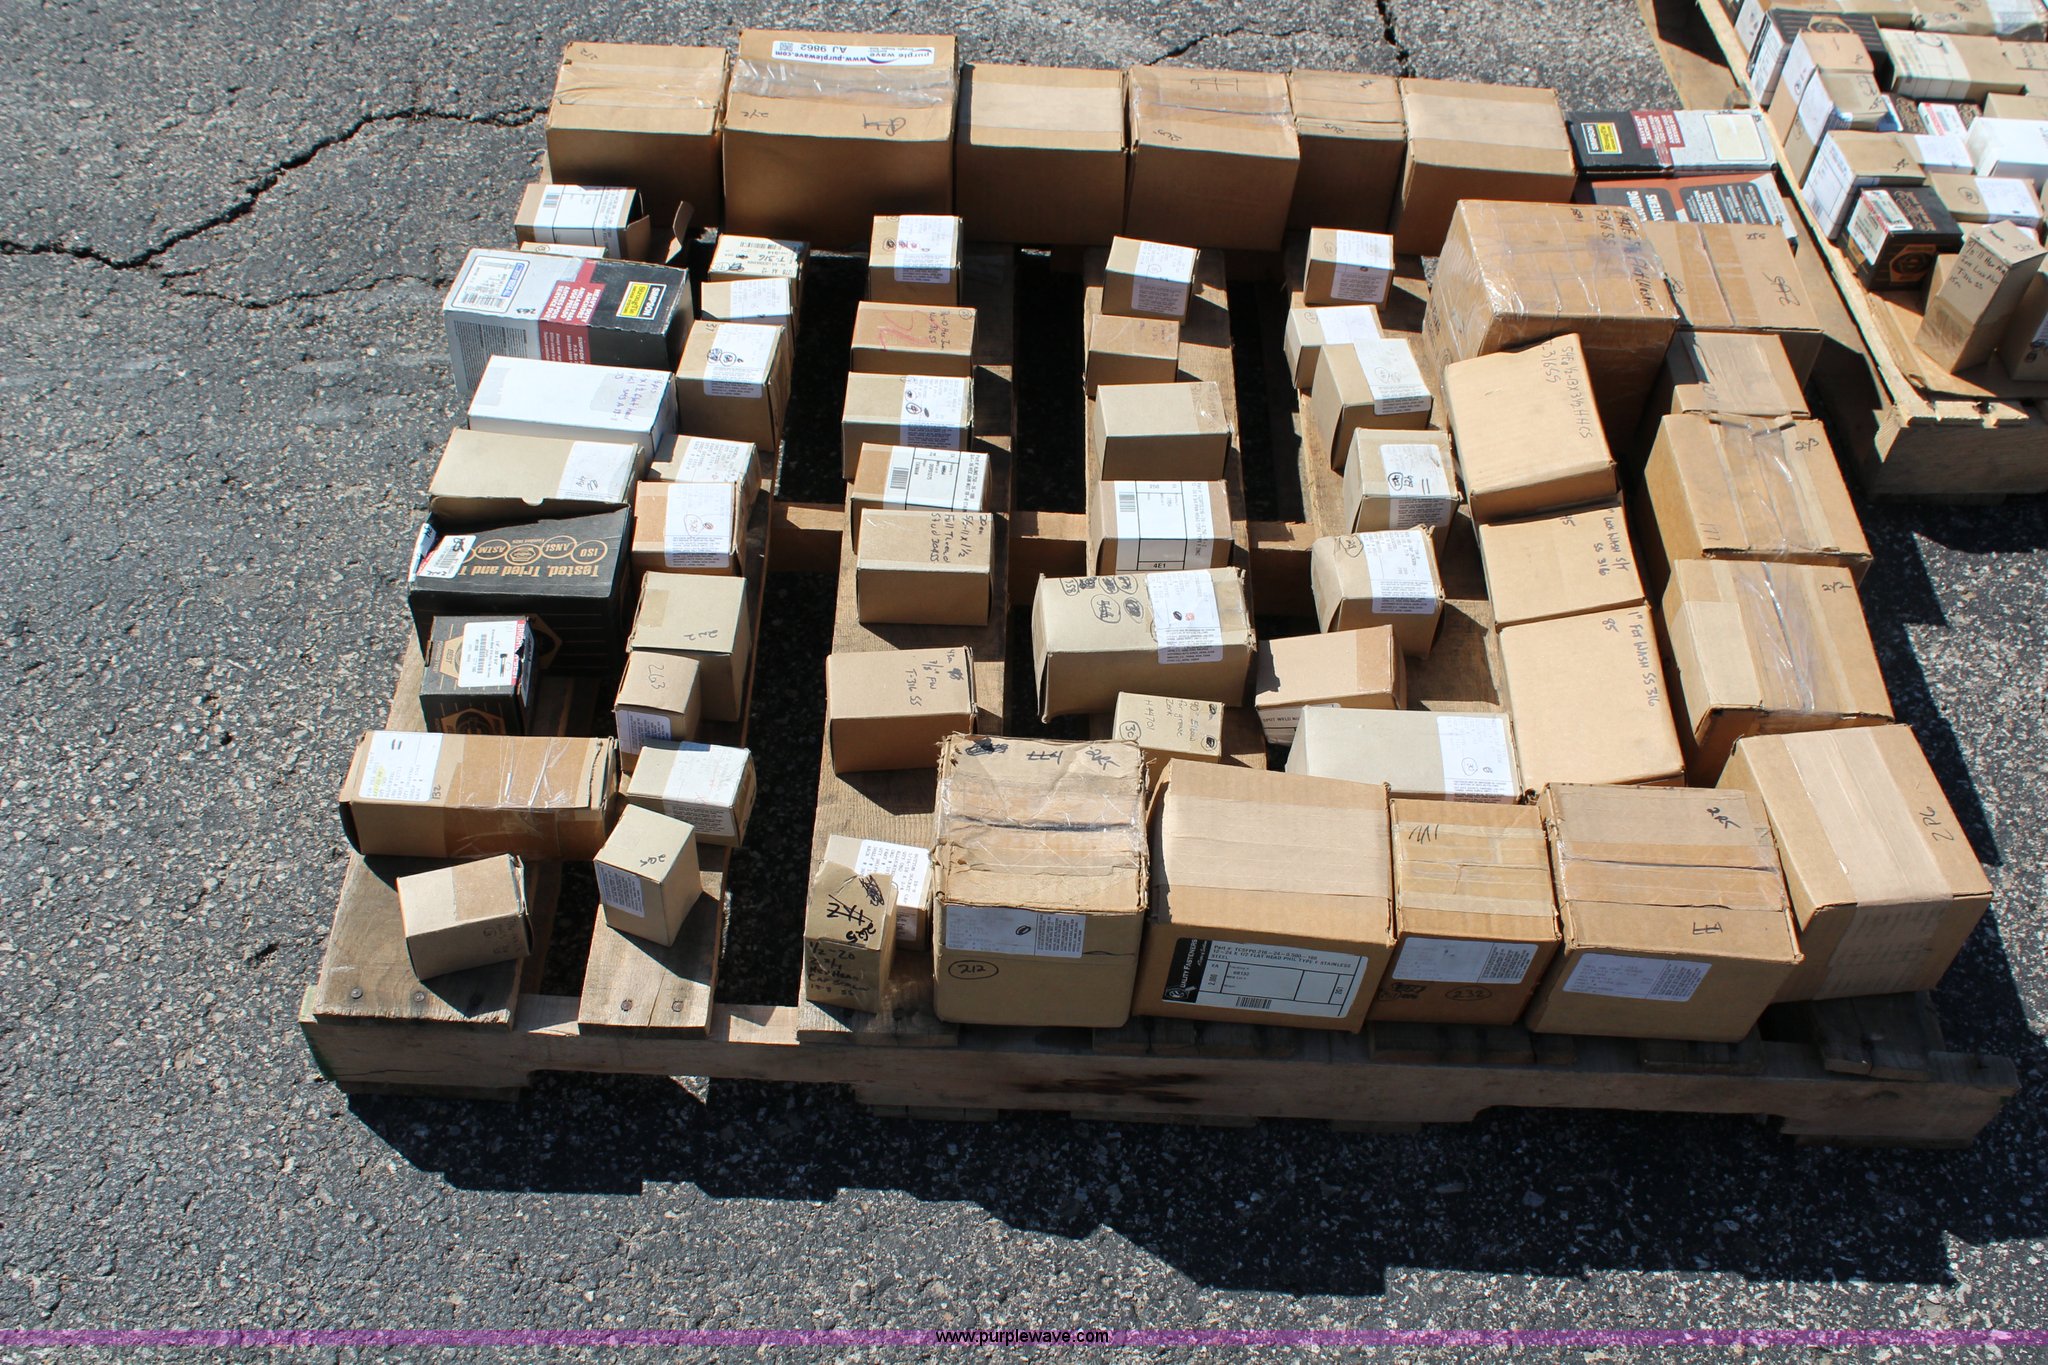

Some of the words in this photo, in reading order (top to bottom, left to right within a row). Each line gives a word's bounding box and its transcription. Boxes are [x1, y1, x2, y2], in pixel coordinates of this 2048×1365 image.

[800, 44, 828, 53] 9862
[831, 46, 848, 54] AJ
[775, 51, 868, 63] www.purplewave.com
[868, 52, 896, 60] wave
[897, 51, 931, 60] purple
[642, 286, 662, 317] SIMPSON
[930, 512, 941, 537] Stud
[476, 546, 507, 555] ASTM
[544, 543, 571, 554] ANSI
[579, 547, 599, 558] ISO
[471, 565, 501, 577] and
[503, 564, 541, 578] Tried
[546, 564, 600, 578] Tested.
[1633, 641, 1649, 669] WASH
[904, 668, 918, 692] T-316
[1641, 672, 1657, 686] SS
[908, 695, 923, 707] SS
[1645, 687, 1661, 708] 316
[962, 963, 992, 975] 212
